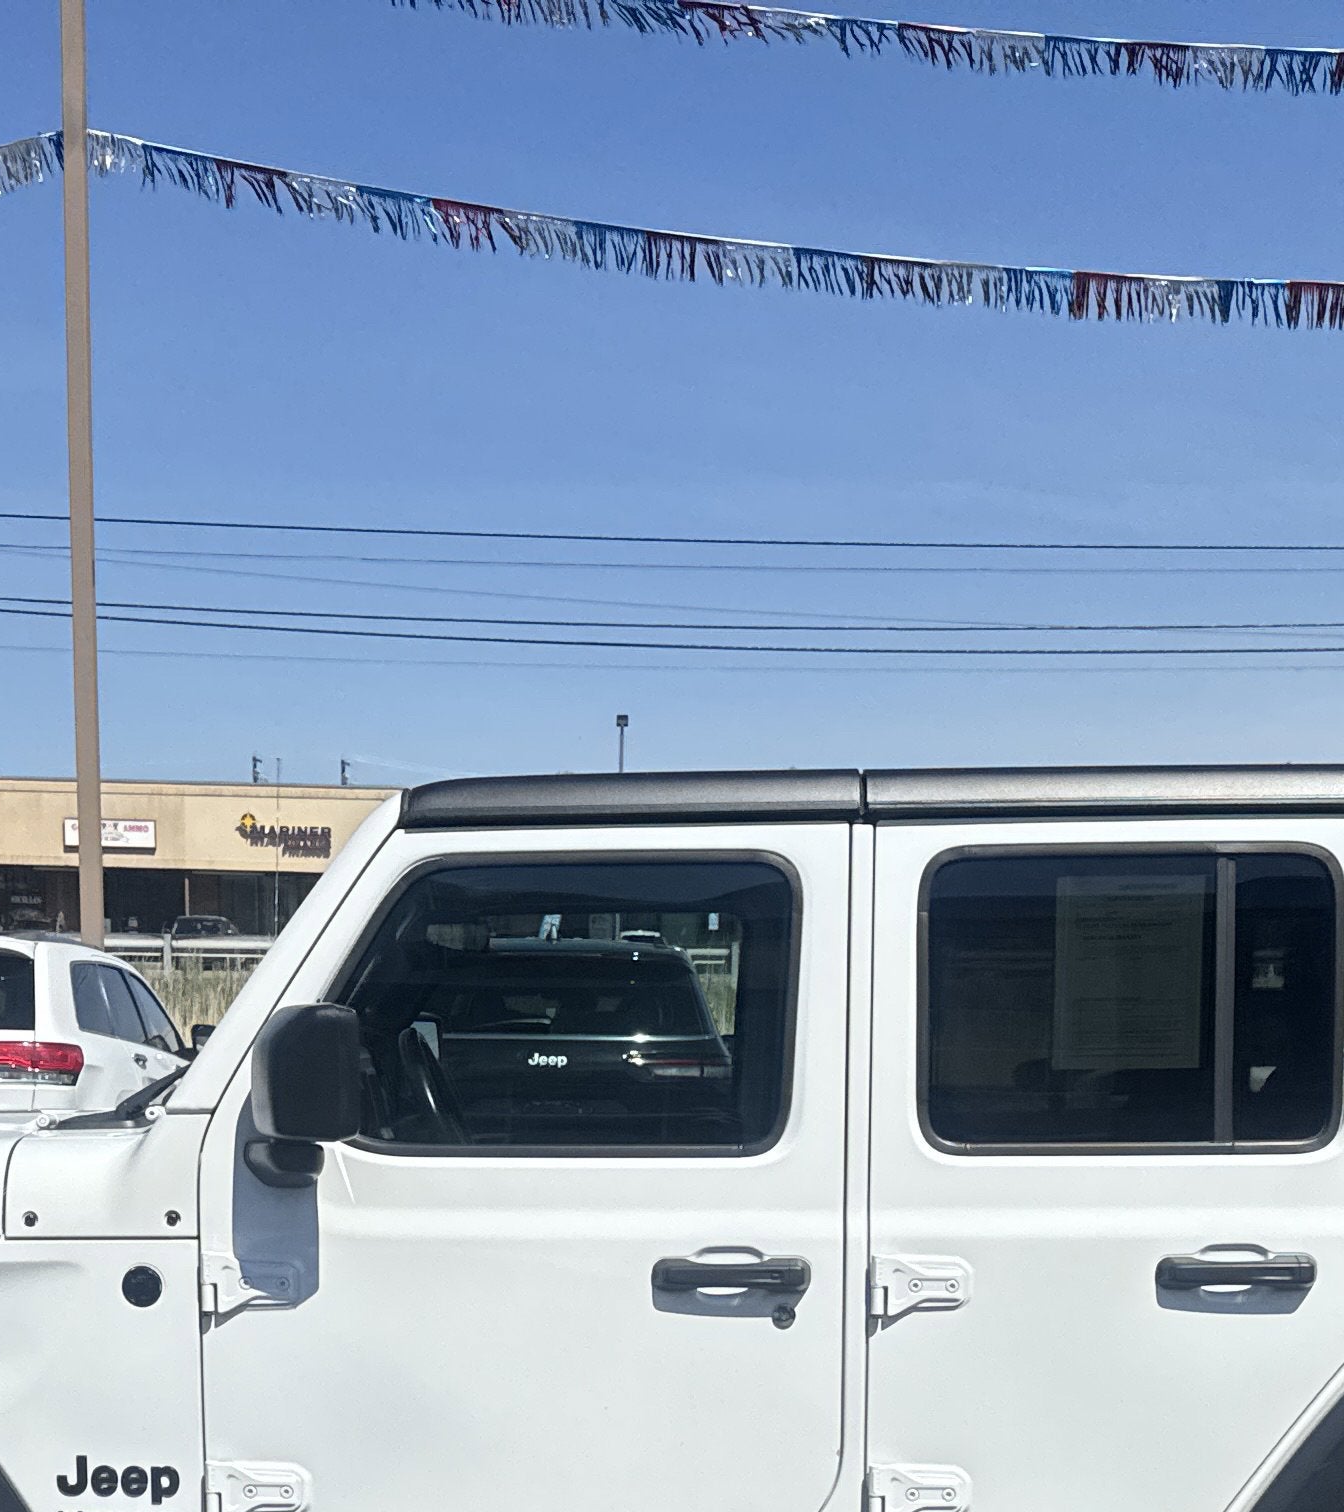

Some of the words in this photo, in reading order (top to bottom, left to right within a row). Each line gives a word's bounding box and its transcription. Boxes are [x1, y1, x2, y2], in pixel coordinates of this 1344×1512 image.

[249, 825, 331, 839] MARINER
[528, 1052, 567, 1068] Jeep
[56, 1455, 180, 1505] Jeep
